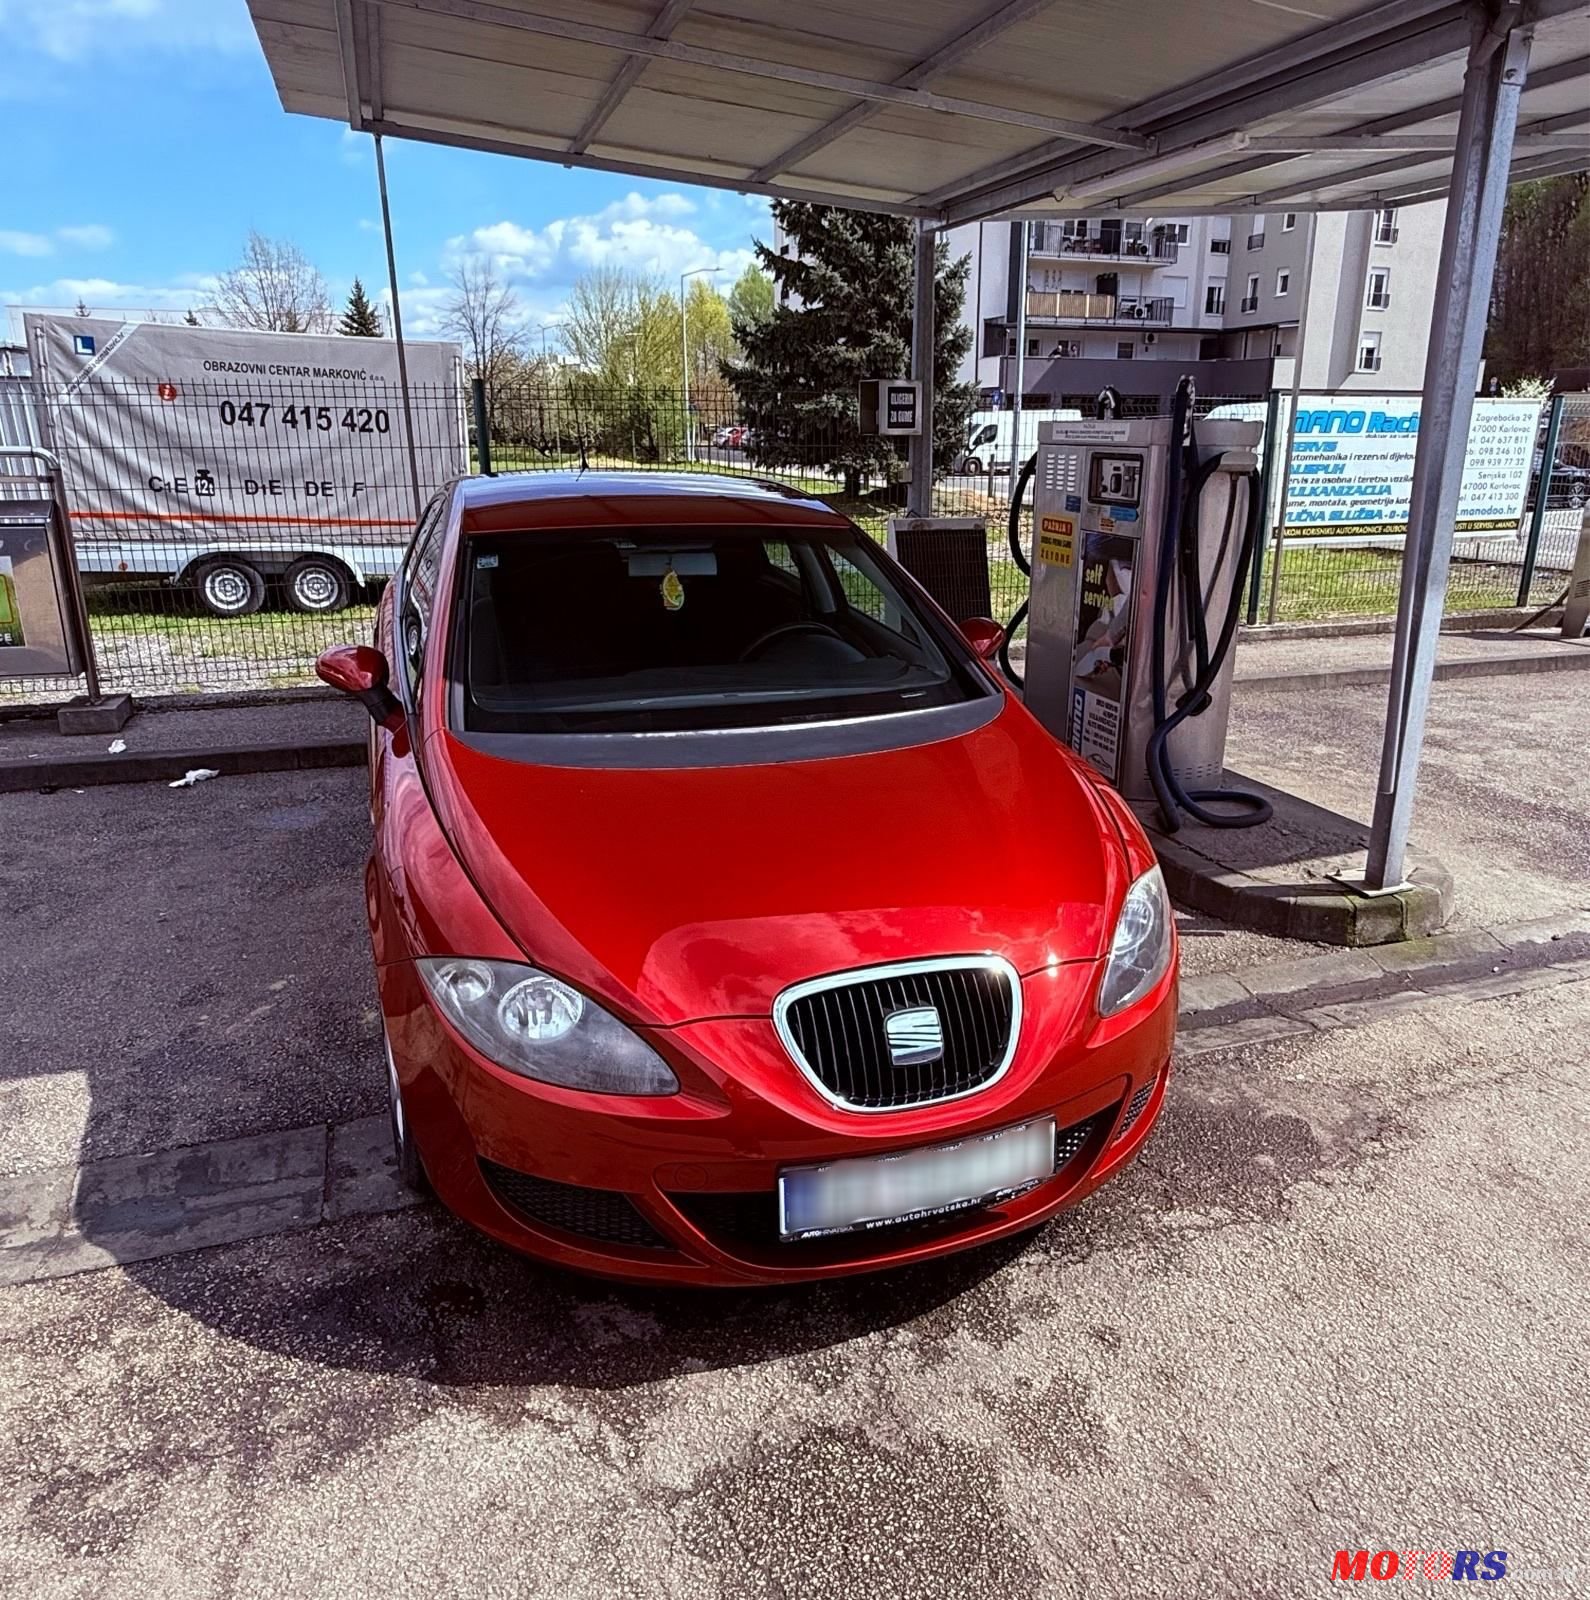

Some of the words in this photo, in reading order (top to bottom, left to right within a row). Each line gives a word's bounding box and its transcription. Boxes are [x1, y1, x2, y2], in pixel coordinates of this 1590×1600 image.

[203, 360, 266, 375] OBRAZOVNI
[268, 365, 311, 378] CENTAR
[313, 367, 367, 381] MARKOVIĆ
[220, 400, 271, 427] 047
[281, 404, 332, 431] 415
[341, 407, 390, 434] 420
[1366, 411, 1420, 434] Raci
[1475, 412, 1520, 423] Zagrebačka
[1522, 413, 1533, 421] 29
[1472, 425, 1497, 433] 47000
[1498, 424, 1531, 433] Karlovac
[1480, 436, 1496, 444] 047
[1497, 436, 1512, 444] 637
[1514, 436, 1528, 444] 811
[1291, 452, 1348, 461] utomehanika
[1478, 447, 1494, 456] 098
[1495, 447, 1510, 456] 246
[1513, 447, 1526, 455] 101
[1469, 458, 1485, 466] 098
[1487, 458, 1501, 466] 939
[1503, 458, 1513, 466] 77
[1515, 458, 1525, 466] 32
[1287, 476, 1309, 485] ervis
[1321, 475, 1352, 484] osobna
[1358, 475, 1388, 483] teretna
[1509, 470, 1523, 479] 102
[305, 480, 335, 497] DE
[1462, 482, 1488, 491] 47000
[1489, 482, 1521, 490] Karlovac
[1470, 493, 1486, 501] 047
[1488, 493, 1503, 501] 413
[1504, 492, 1519, 501] 300
[1350, 497, 1394, 508] geometrija
[1327, 507, 1383, 521] SLUŽBA
[1456, 504, 1518, 516] .manodoo.hr
[1302, 527, 1335, 536] KORISNIKU
[1335, 525, 1382, 535] AUTOPRAONICE
[1455, 522, 1468, 531] USTI
[1472, 521, 1495, 530] SERVISU
[1085, 564, 1103, 585] self
[865, 1197, 982, 1229] www.autohrvatska.hr
